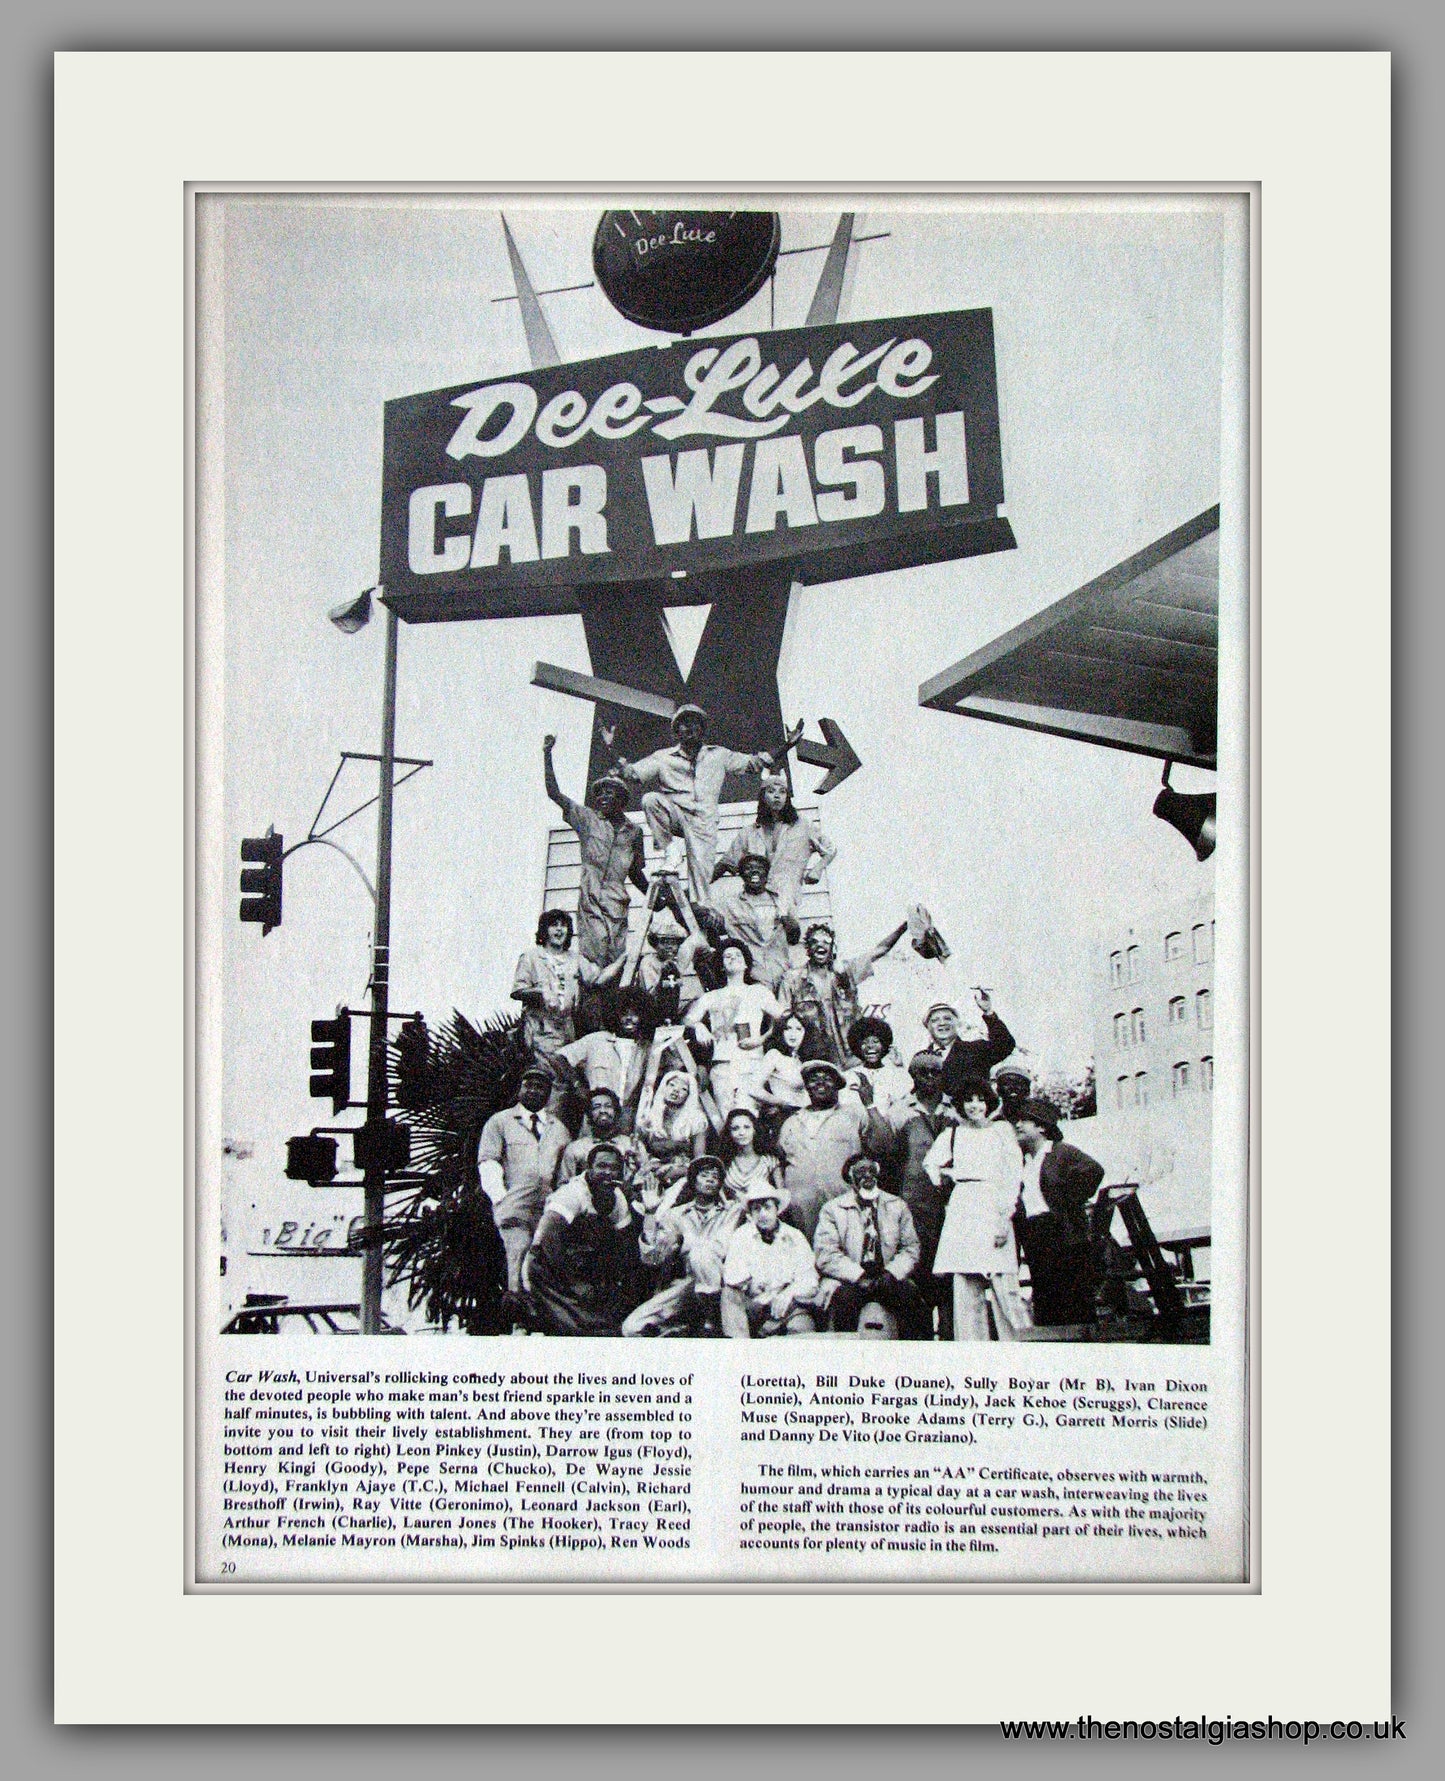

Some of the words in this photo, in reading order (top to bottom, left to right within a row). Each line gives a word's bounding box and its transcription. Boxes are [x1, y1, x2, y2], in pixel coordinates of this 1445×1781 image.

[446, 336, 940, 461] Dee-Luxe
[407, 463, 609, 576] CAR
[640, 412, 970, 546] WASH
[225, 1370, 253, 1383] Car
[259, 1370, 301, 1384] Wash,
[306, 1370, 380, 1383] Universal's
[385, 1371, 448, 1387] rollicking
[452, 1372, 506, 1387] comedy
[510, 1372, 548, 1384] about
[578, 1372, 607, 1385] lives
[641, 1373, 675, 1385] loves
[741, 1375, 806, 1389] (Loretta),
[816, 1375, 838, 1388] Bill
[849, 1375, 885, 1388] Duke
[895, 1376, 954, 1390] (Duane),
[964, 1377, 998, 1392] Sully
[1009, 1377, 1050, 1393] Boyar
[1125, 1379, 1155, 1391] Ivan
[1166, 1379, 1207, 1392] Dixon
[249, 1389, 303, 1401] devoted
[307, 1389, 351, 1404] people
[388, 1389, 425, 1402] make
[429, 1389, 468, 1402] man's
[472, 1390, 500, 1402] best
[503, 1390, 542, 1402] friend
[546, 1391, 595, 1406] sparkle
[615, 1395, 652, 1403] seven
[740, 1392, 802, 1406] (Lonnie),
[809, 1392, 864, 1405] Antonio
[871, 1393, 918, 1409] Fargas
[924, 1394, 979, 1410] (Lindy),
[984, 1395, 1016, 1408] Jack
[1023, 1395, 1066, 1408] Kehoe
[1147, 1398, 1208, 1411] Clarence
[224, 1407, 252, 1419] half
[255, 1407, 312, 1421] minutes,
[332, 1407, 391, 1423] bubbling
[396, 1407, 425, 1420] with
[430, 1408, 471, 1420] talent.
[477, 1408, 506, 1420] And
[510, 1408, 550, 1421] above
[555, 1409, 600, 1424] they're
[605, 1410, 674, 1422] assembled
[741, 1411, 778, 1423] Muse
[784, 1411, 854, 1427] (Snapper),
[861, 1412, 910, 1425] Brooke
[918, 1412, 966, 1425] Adams
[972, 1413, 1013, 1429] (Terry
[1055, 1414, 1105, 1427] Garrett
[1112, 1415, 1158, 1428] Morris
[1164, 1416, 1207, 1430] (Slide)
[224, 1425, 261, 1438] invite
[321, 1425, 348, 1438] visit
[355, 1425, 386, 1438] their
[393, 1425, 428, 1441] lively
[435, 1426, 531, 1439] establishment.
[539, 1426, 572, 1442] They
[606, 1427, 644, 1441] (from
[769, 1429, 814, 1444] Danny
[842, 1429, 870, 1442] Vito
[873, 1430, 901, 1444] (Joe
[905, 1430, 977, 1444] Graziano).
[224, 1444, 273, 1456] bottom
[309, 1443, 330, 1456] left
[354, 1443, 391, 1459] right)
[396, 1444, 430, 1456] Leon
[436, 1444, 482, 1459] Pinkey
[487, 1444, 541, 1458] (Justin),
[546, 1445, 598, 1457] Darrow
[604, 1445, 632, 1461] Igus
[637, 1445, 692, 1461] (Floyd),
[224, 1462, 267, 1477] Henry
[278, 1461, 316, 1477] Kingi
[325, 1461, 387, 1477] (Goody),
[397, 1462, 430, 1477] Pepe
[439, 1461, 478, 1474] Serna
[487, 1462, 556, 1476] (Chucko),
[596, 1463, 643, 1479] Wayne
[653, 1464, 691, 1476] Jessie
[788, 1464, 817, 1478] film,
[821, 1465, 861, 1478] which
[864, 1466, 910, 1478] carries
[978, 1467, 1053, 1482] Certificate,
[1057, 1468, 1115, 1482] observes
[1118, 1470, 1147, 1482] with
[223, 1480, 278, 1495] (Lloyd),
[286, 1480, 348, 1495] Franklyn
[356, 1480, 396, 1495] Ajaye
[455, 1480, 508, 1493] Michael
[516, 1481, 565, 1493] Fennell
[571, 1481, 630, 1495] (Calvin),
[637, 1482, 691, 1494] Richard
[741, 1482, 794, 1495] humour
[827, 1483, 870, 1496] drama
[887, 1484, 932, 1499] typical
[1063, 1487, 1149, 1504] interweaving
[1177, 1489, 1207, 1502] lives
[223, 1497, 287, 1510] Bresthoff
[293, 1497, 344, 1512] (Irwin),
[353, 1497, 380, 1513] Ray
[390, 1498, 422, 1510] Vitte
[429, 1498, 513, 1512] (Geronimo),
[521, 1498, 578, 1511] Leonard
[585, 1499, 640, 1512] Jackson
[648, 1500, 691, 1514] (Earl),
[783, 1500, 813, 1513] staff
[815, 1501, 844, 1513] with
[849, 1501, 884, 1514] those
[925, 1503, 986, 1516] colourful
[990, 1506, 1063, 1517] customers.
[1091, 1506, 1120, 1518] with
[1149, 1507, 1205, 1523] majority
[223, 1516, 270, 1529] Arthur
[277, 1516, 325, 1528] French
[332, 1516, 396, 1530] (Charlie),
[403, 1516, 452, 1529] Lauren
[458, 1516, 496, 1529] Jones
[503, 1517, 534, 1530] (The
[542, 1517, 602, 1531] Hooker),
[611, 1518, 647, 1533] Tracy
[657, 1518, 690, 1531] Reed
[758, 1519, 806, 1534] people,
[836, 1520, 900, 1532] transistor
[905, 1520, 940, 1533] radio
[981, 1522, 1038, 1535] essential
[1042, 1525, 1070, 1538] part
[1093, 1524, 1124, 1536] their
[1167, 1526, 1207, 1539] which
[222, 1534, 278, 1549] (Mona),
[282, 1534, 336, 1546] Melanie
[341, 1534, 396, 1550] Mayron
[400, 1534, 468, 1549] (Marsha),
[471, 1534, 495, 1547] Jim
[500, 1535, 545, 1550] Spinks
[549, 1535, 606, 1551] (Hippo),
[611, 1536, 638, 1548] Ren
[643, 1536, 690, 1548] Woods
[740, 1539, 800, 1549] accounts
[826, 1537, 865, 1553] plenty
[887, 1539, 926, 1551] music
[969, 1539, 998, 1552] film.
[221, 1561, 236, 1574] 20
